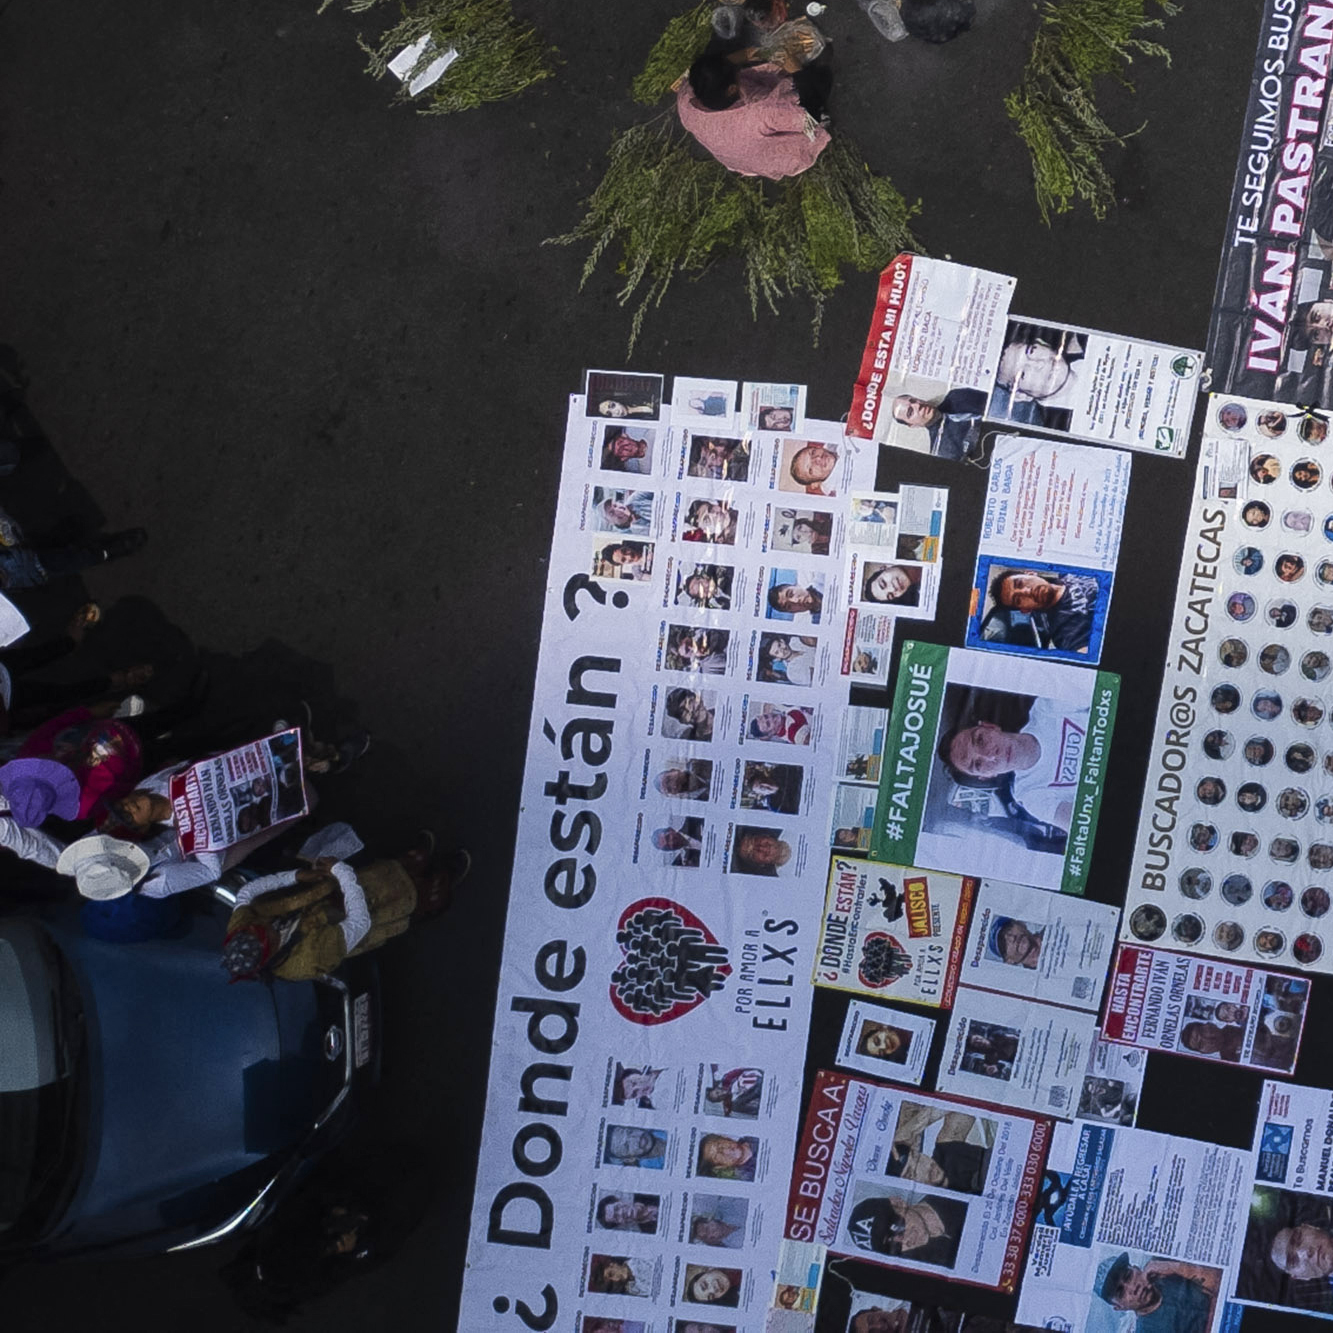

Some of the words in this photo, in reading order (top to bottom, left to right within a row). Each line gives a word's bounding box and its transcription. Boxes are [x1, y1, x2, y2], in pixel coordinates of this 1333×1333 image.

[1241, 56, 1286, 207] SEGUIMOS
[1234, 212, 1261, 248] TE
[887, 261, 908, 305] HIJO?
[882, 307, 898, 326] MI
[1244, 248, 1298, 371] IVÁN
[873, 330, 893, 369] ESTA
[859, 372, 884, 430] ¿DONDE
[564, 574, 628, 620] ?
[1141, 684, 1197, 891] BUSCADOR@S
[1177, 507, 1226, 674] ZACATECAS
[885, 662, 933, 841] #FALTAJOSUÉ
[544, 657, 620, 908] están
[1069, 688, 1113, 877] #FaltaUnx_FaltanTodxs
[744, 928, 761, 937] A
[902, 881, 935, 936] JALISCO
[739, 941, 759, 982] AMOR
[749, 915, 802, 1032] ELLXS
[920, 944, 944, 995] ELLXS
[1151, 959, 1170, 984] IVÁN
[1168, 956, 1191, 1002] ORNELAS
[734, 985, 754, 1014] POR
[1111, 971, 1131, 1013] HASTA
[1122, 951, 1151, 1040] ENCONTRARTE
[1141, 985, 1165, 1038] FERNANDO
[1159, 1003, 1181, 1048] ORNELAS
[488, 941, 585, 1248] Donde
[799, 1105, 839, 1198] BUSCA
[817, 1188, 845, 1246] Salvador
[841, 1083, 867, 1131] Vargas
[1295, 1117, 1314, 1173] Buscamos
[1315, 1146, 1332, 1191] MANUEL
[1292, 1175, 1304, 1189] Te
[789, 1204, 817, 1241] SE
